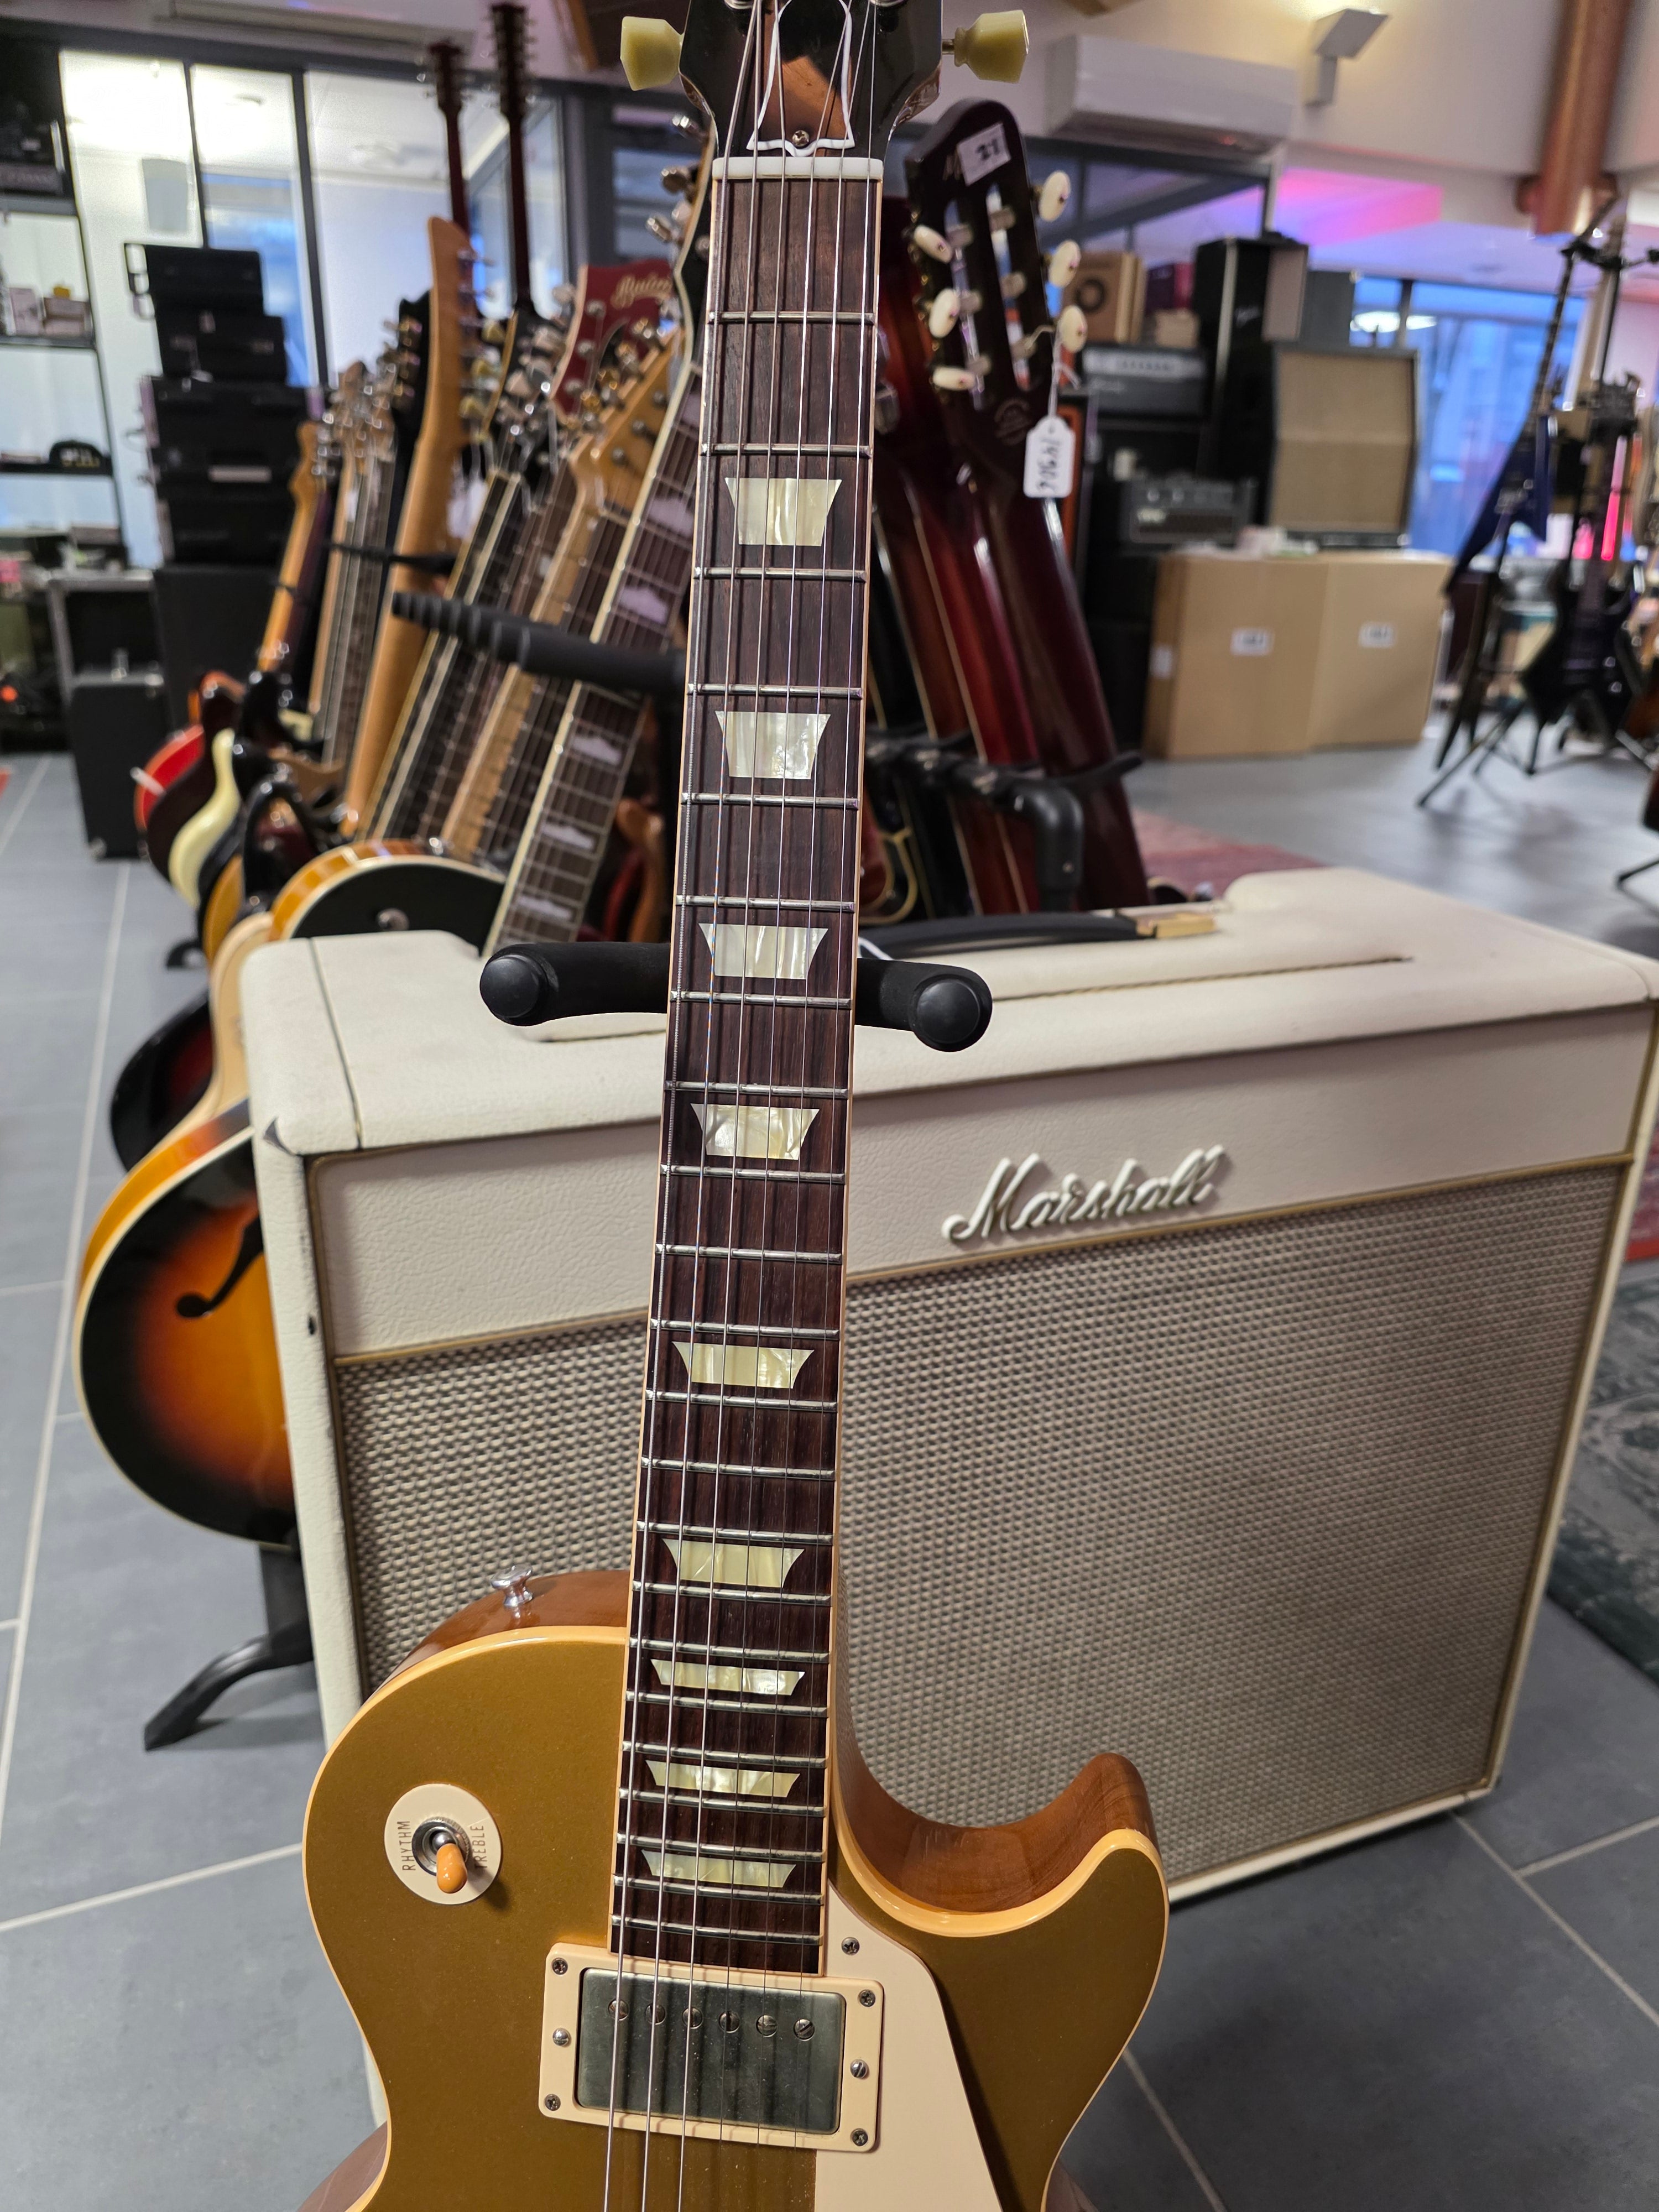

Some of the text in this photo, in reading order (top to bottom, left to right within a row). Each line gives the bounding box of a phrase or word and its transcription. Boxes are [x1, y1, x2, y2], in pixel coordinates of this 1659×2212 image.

[942, 1144, 1225, 1240] Marshall
[397, 1820, 416, 1871] RHYTHM
[470, 1825, 488, 1868] TREBLE
